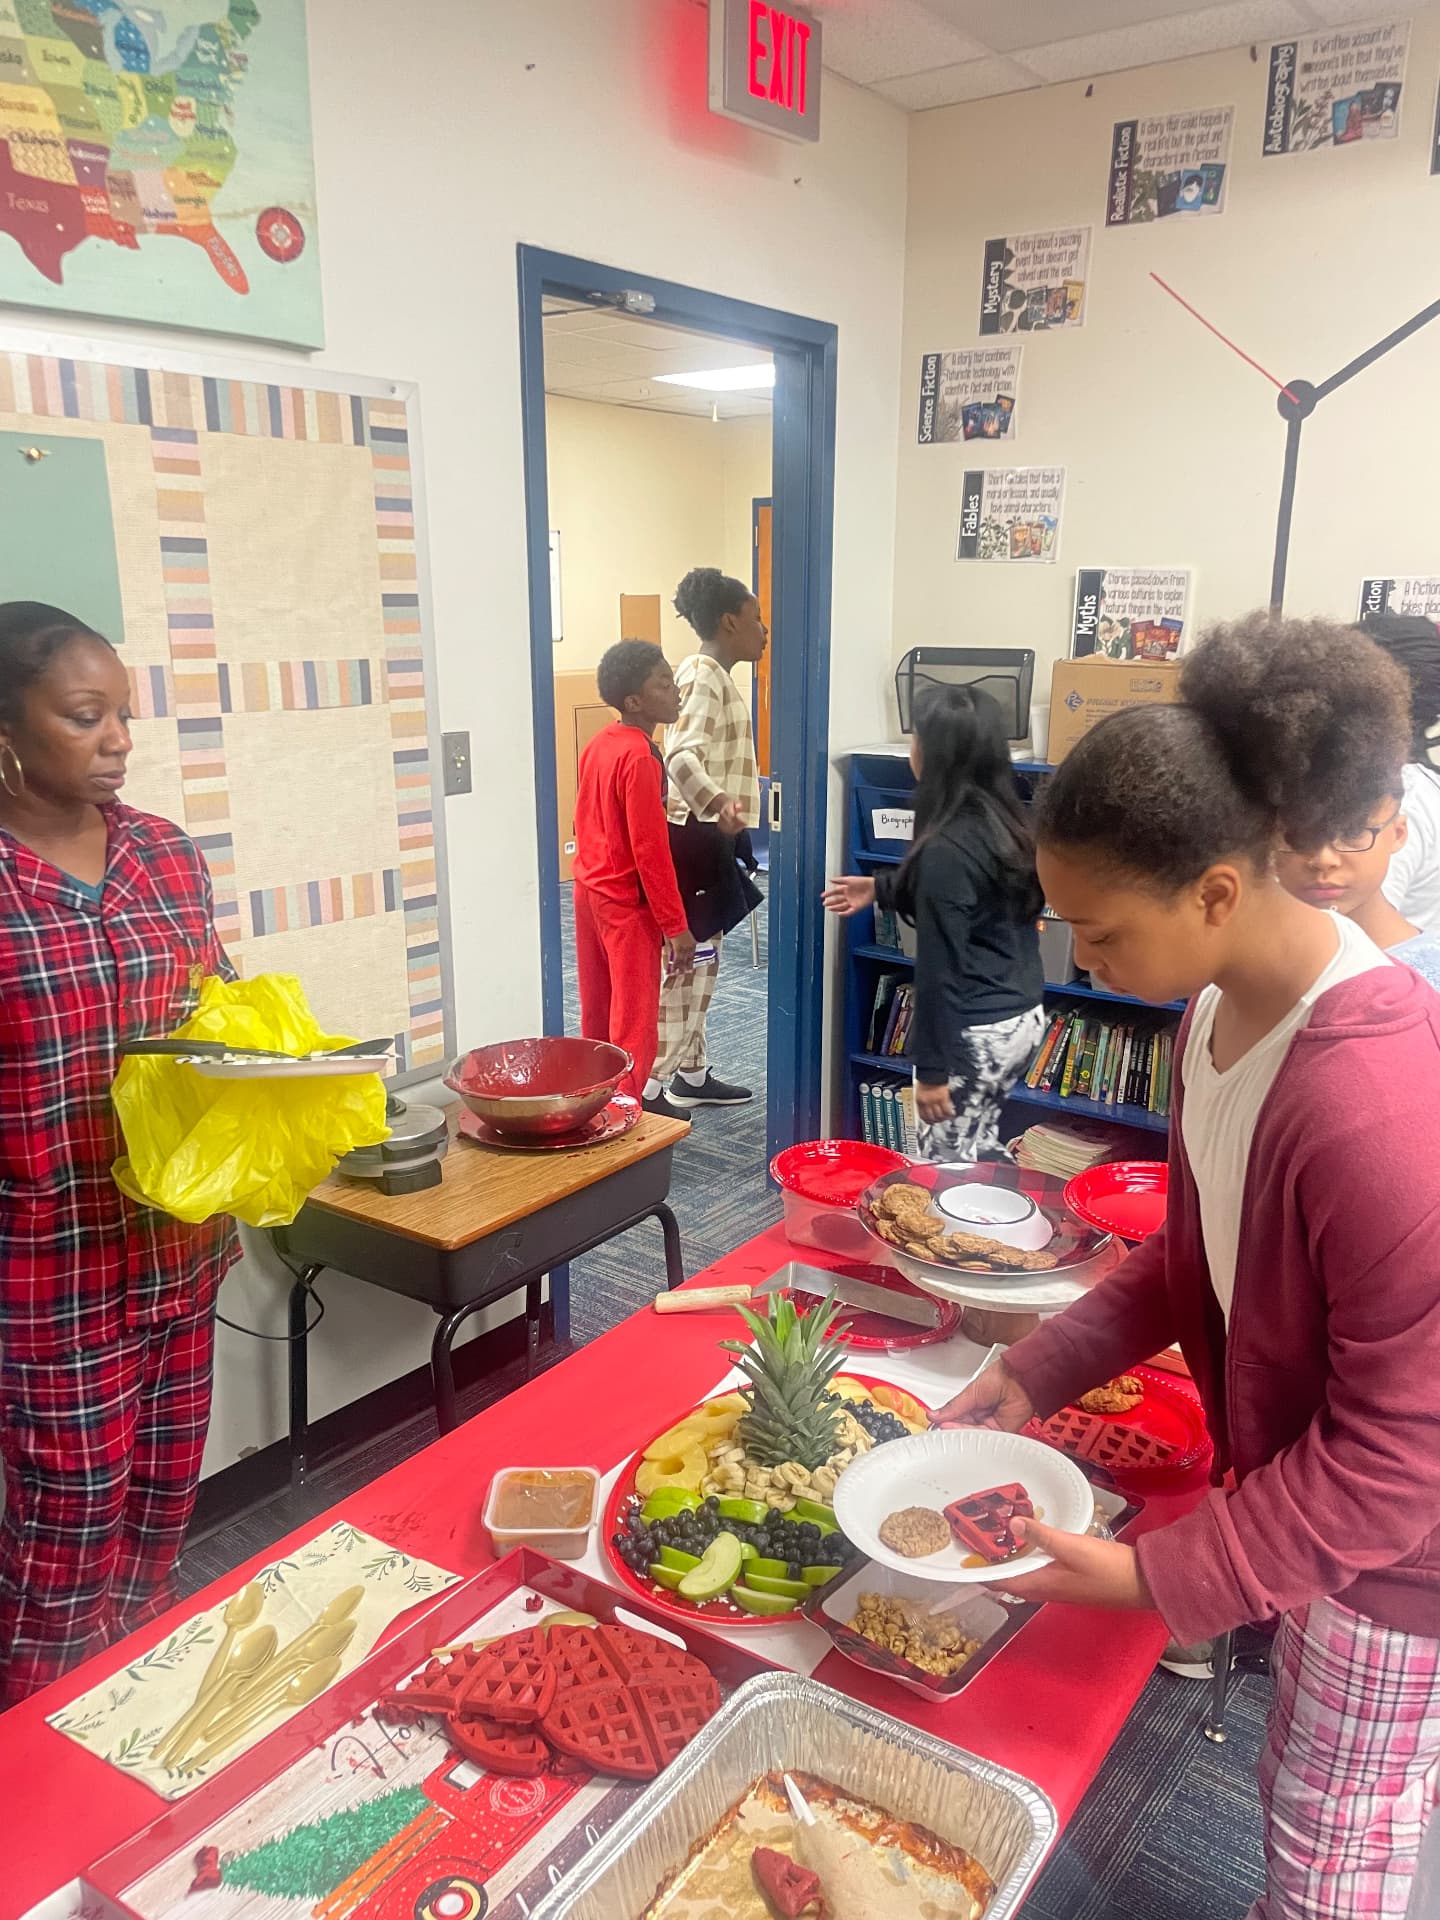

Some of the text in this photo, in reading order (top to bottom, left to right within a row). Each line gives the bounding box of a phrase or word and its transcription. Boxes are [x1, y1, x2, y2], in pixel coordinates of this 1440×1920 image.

[1312, 39, 1318, 54] A
[1319, 33, 1351, 52] written
[1351, 27, 1381, 46] account
[42, 49, 70, 65] Iowa
[748, 0, 811, 116] EXIT
[1302, 56, 1339, 75] eone's
[1341, 53, 1354, 68] life
[1356, 50, 1372, 65] that
[145, 81, 173, 94] Ohio
[1300, 75, 1329, 92] written
[1330, 71, 1352, 87] about
[1265, 45, 1294, 153] Autobiography
[1141, 122, 1145, 135] A
[1146, 119, 1165, 137] story
[1167, 118, 1178, 131] that
[1199, 112, 1222, 127] happen
[1170, 133, 1184, 147] but
[1185, 132, 1195, 145] the
[1212, 128, 1223, 141] and
[1179, 149, 1190, 162] are
[1111, 127, 1132, 222] Realistic Fiction
[6, 192, 50, 213] Texas
[1014, 239, 1018, 252] A
[1020, 239, 1035, 253] story
[1036, 236, 1053, 249] about
[1053, 235, 1058, 246] a
[1015, 247, 1078, 267] event that doesn't get
[1017, 269, 1035, 283] solved
[1036, 267, 1048, 280] until
[1050, 266, 1059, 278] the
[984, 260, 1003, 314] Mystery
[951, 349, 1011, 367] A story that combines
[946, 364, 1015, 380] futuristic technology with
[944, 382, 969, 395] scientific
[971, 381, 981, 393] fact
[982, 381, 992, 392] and
[920, 356, 937, 442] Science Fiction
[988, 473, 1002, 484] Short
[1029, 472, 1040, 483] that
[1041, 472, 1054, 483] have
[1056, 472, 1060, 483] a
[986, 488, 1000, 497] moral
[1003, 488, 1008, 497] or
[1030, 487, 1039, 497] and
[1040, 487, 1058, 500] usually
[962, 494, 979, 537] Fables
[991, 502, 1001, 512] have
[1003, 502, 1019, 512] animal
[1108, 573, 1185, 586] Stories passed down from
[1404, 580, 1411, 596] A
[1108, 589, 1183, 600] various cultures to explain
[1076, 594, 1098, 635] Myths
[1105, 603, 1126, 614] natural
[1128, 603, 1144, 615] things
[1146, 603, 1151, 614] in
[1153, 603, 1162, 614] the
[863, 1096, 871, 1133] Intermediate
[875, 1099, 884, 1137] Intermediate
